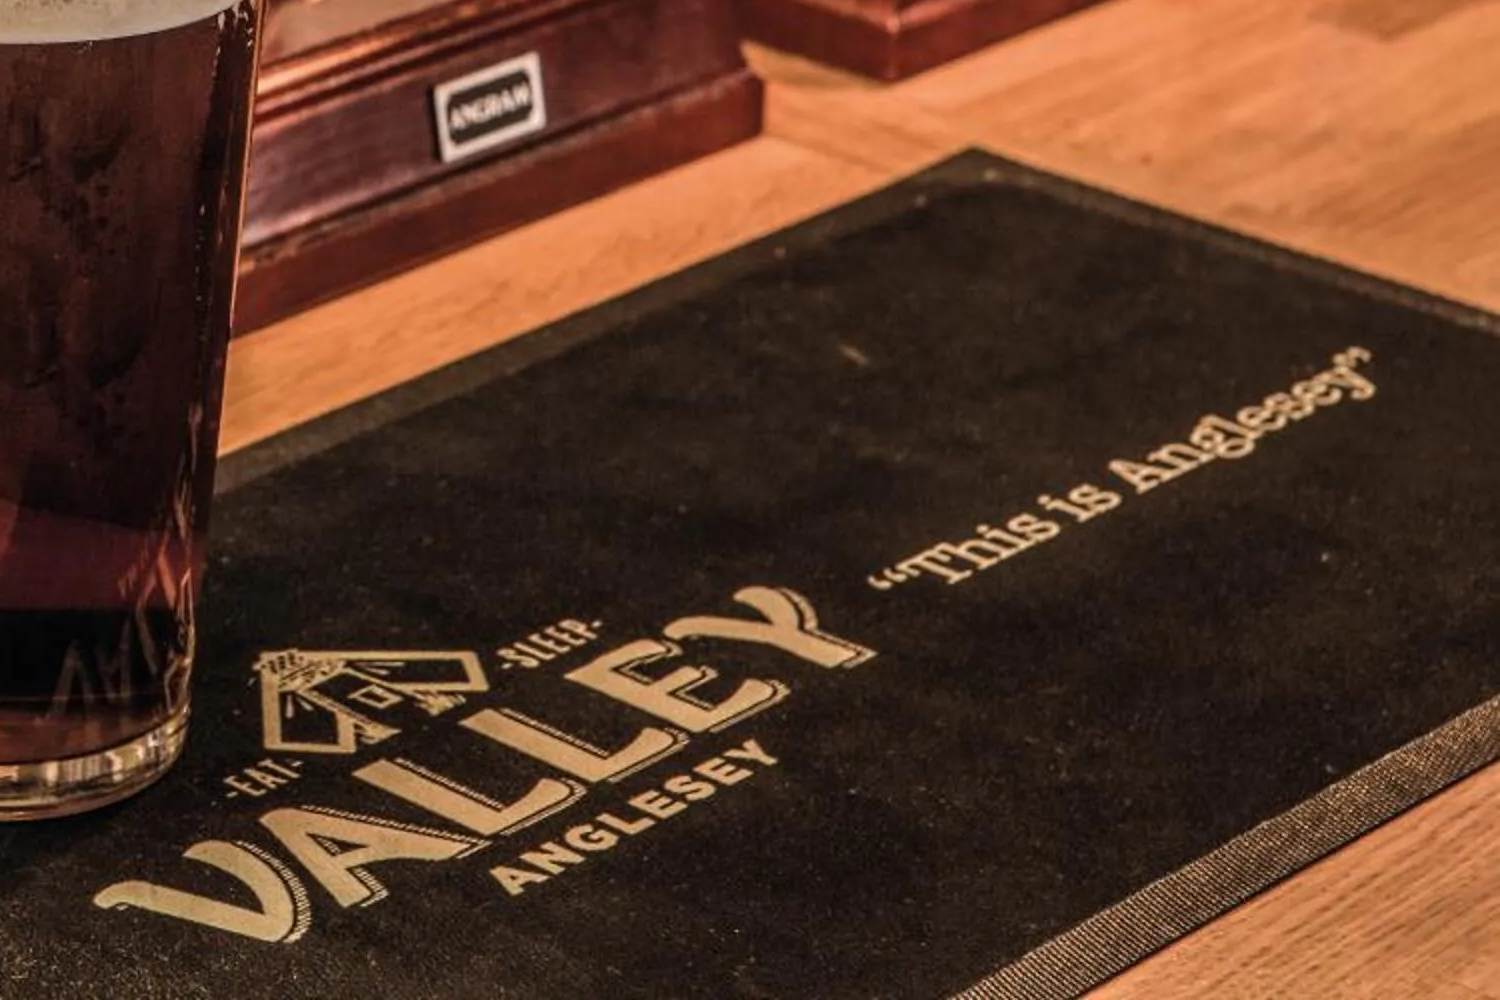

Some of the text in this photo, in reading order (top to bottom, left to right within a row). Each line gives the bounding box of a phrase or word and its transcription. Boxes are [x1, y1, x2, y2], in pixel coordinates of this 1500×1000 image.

[1036, 483, 1123, 522] is
[93, 585, 879, 944] VALLEY
[488, 738, 779, 896] ANGLESEY
